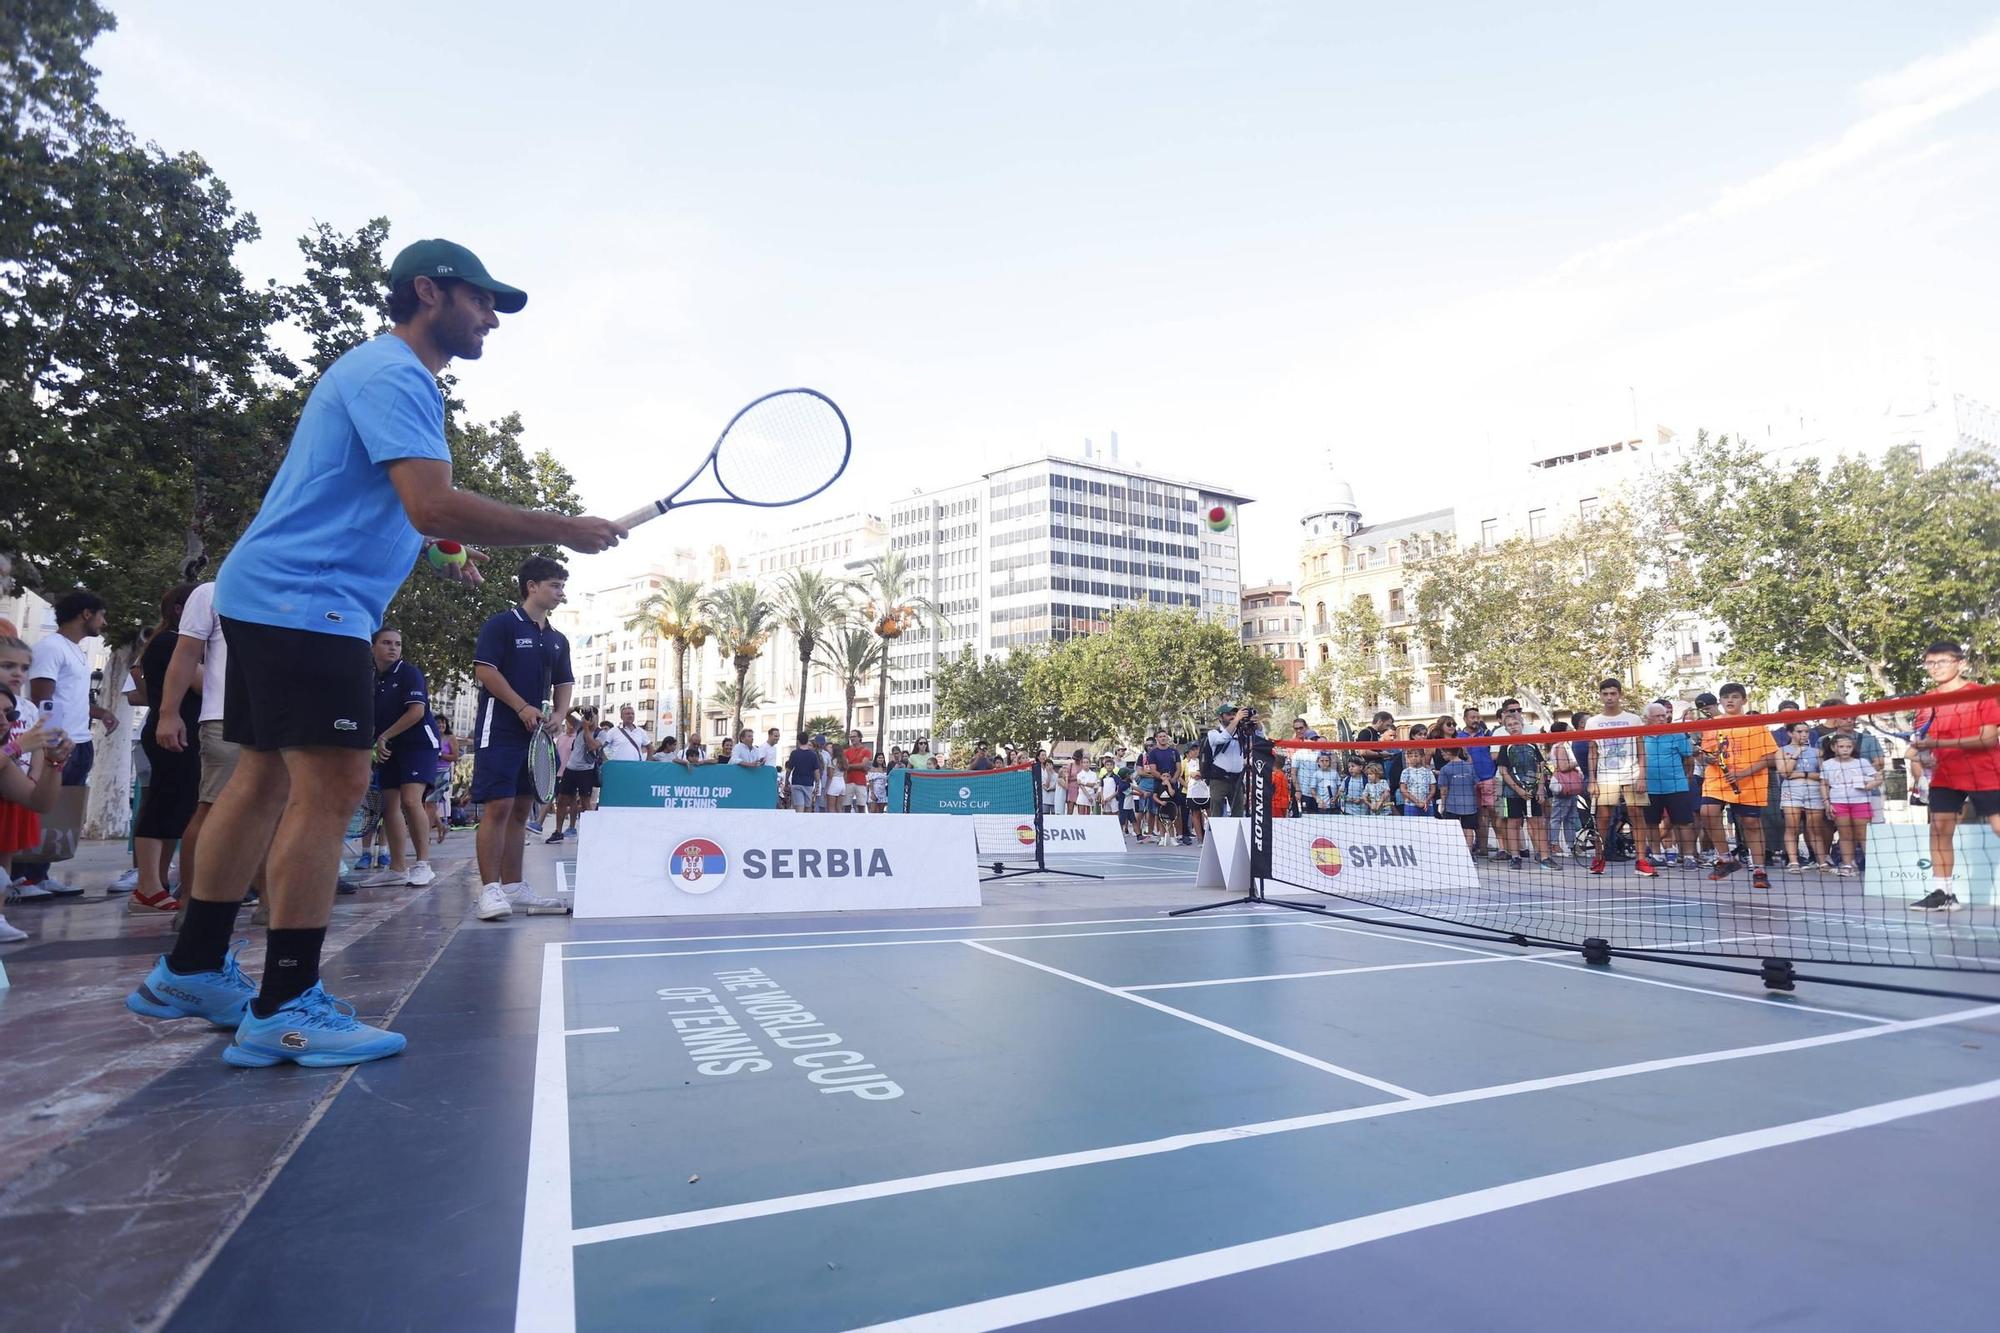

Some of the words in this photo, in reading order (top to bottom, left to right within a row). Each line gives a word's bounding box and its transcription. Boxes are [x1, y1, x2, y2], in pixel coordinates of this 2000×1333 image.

[650, 785, 671, 797] THE
[674, 786, 710, 798] WORLD
[712, 787, 732, 798] CUP
[664, 798, 679, 808] OF
[681, 798, 718, 808] TENNIS
[939, 800, 967, 808] DAVIS
[970, 800, 990, 808] CUP
[1254, 776, 1263, 851] DUNLOP
[1043, 829, 1086, 841] SPAIN
[743, 848, 893, 880] SERBIA
[1349, 844, 1418, 868] SPAIN
[1890, 871, 1928, 881] DAVIS
[713, 967, 780, 991] THE
[156, 982, 203, 1006] LACOSTE
[656, 987, 719, 1003] OF
[735, 990, 843, 1049] WORLD
[668, 1005, 773, 1076] TENNIS
[793, 1050, 905, 1101] CUP
